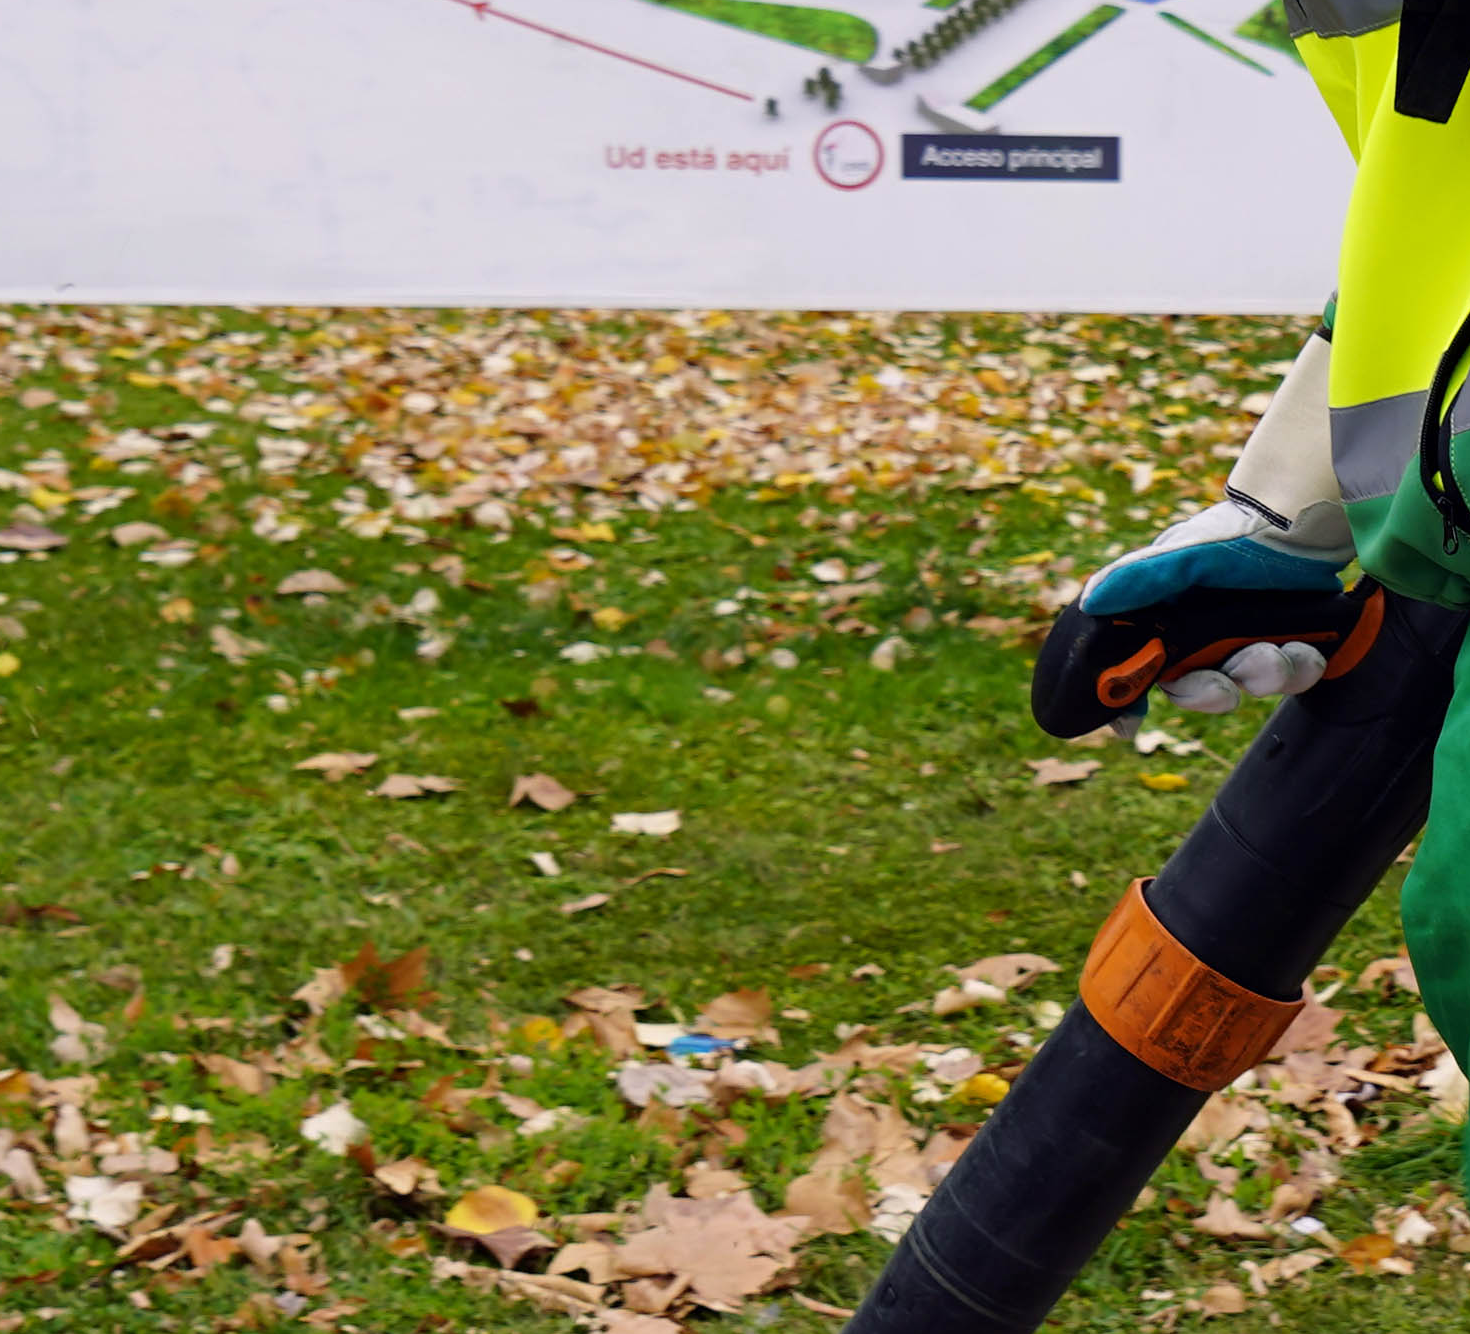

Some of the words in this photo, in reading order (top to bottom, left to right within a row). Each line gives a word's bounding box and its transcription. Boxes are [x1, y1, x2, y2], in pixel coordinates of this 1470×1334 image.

[604, 145, 648, 170] Ud
[654, 144, 717, 170] está
[725, 146, 792, 174] aquí
[921, 144, 1004, 168] Acceso
[1008, 144, 1104, 174] principal
